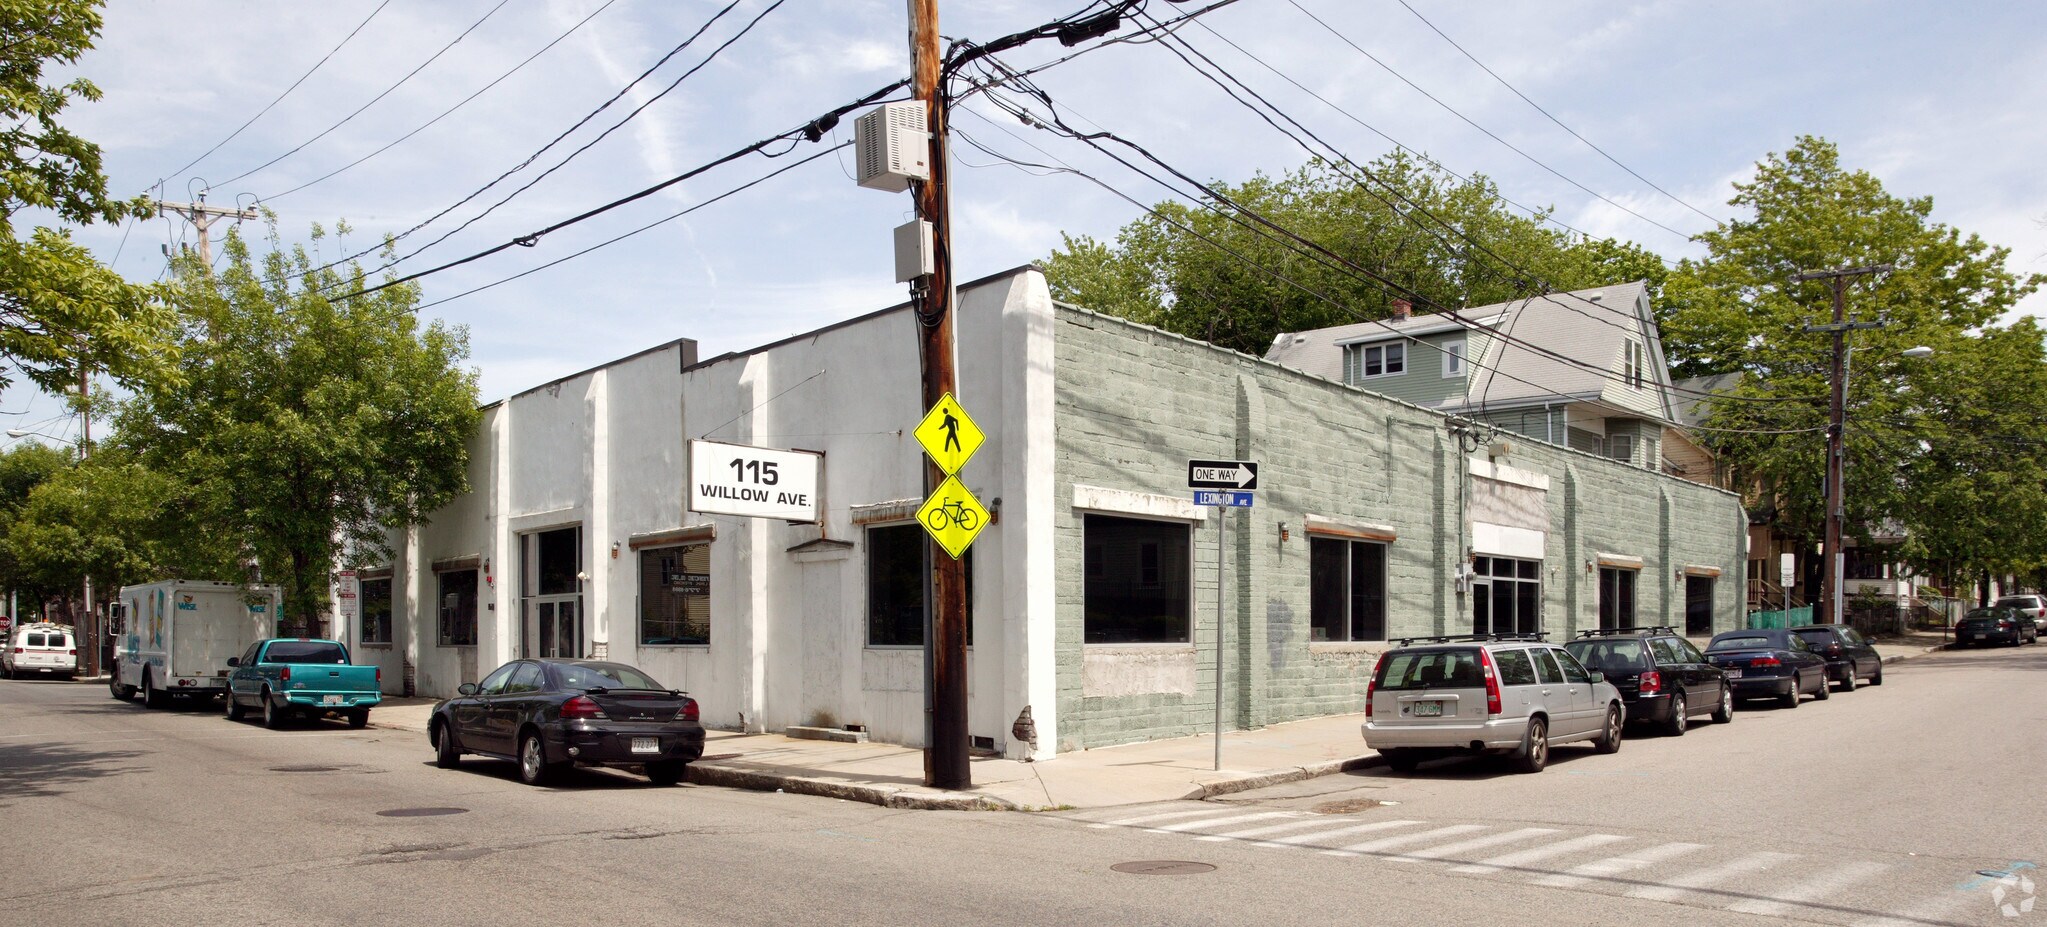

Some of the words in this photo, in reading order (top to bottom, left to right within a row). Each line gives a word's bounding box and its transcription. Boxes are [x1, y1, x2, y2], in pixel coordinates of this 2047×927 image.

[730, 458, 779, 485] 115
[1195, 469, 1215, 480] ONE
[1218, 469, 1237, 480] WAY
[700, 484, 769, 502] WILLOW
[777, 492, 811, 507] AVE.
[1200, 492, 1234, 505] LEXINGTON
[178, 602, 197, 611] WISE
